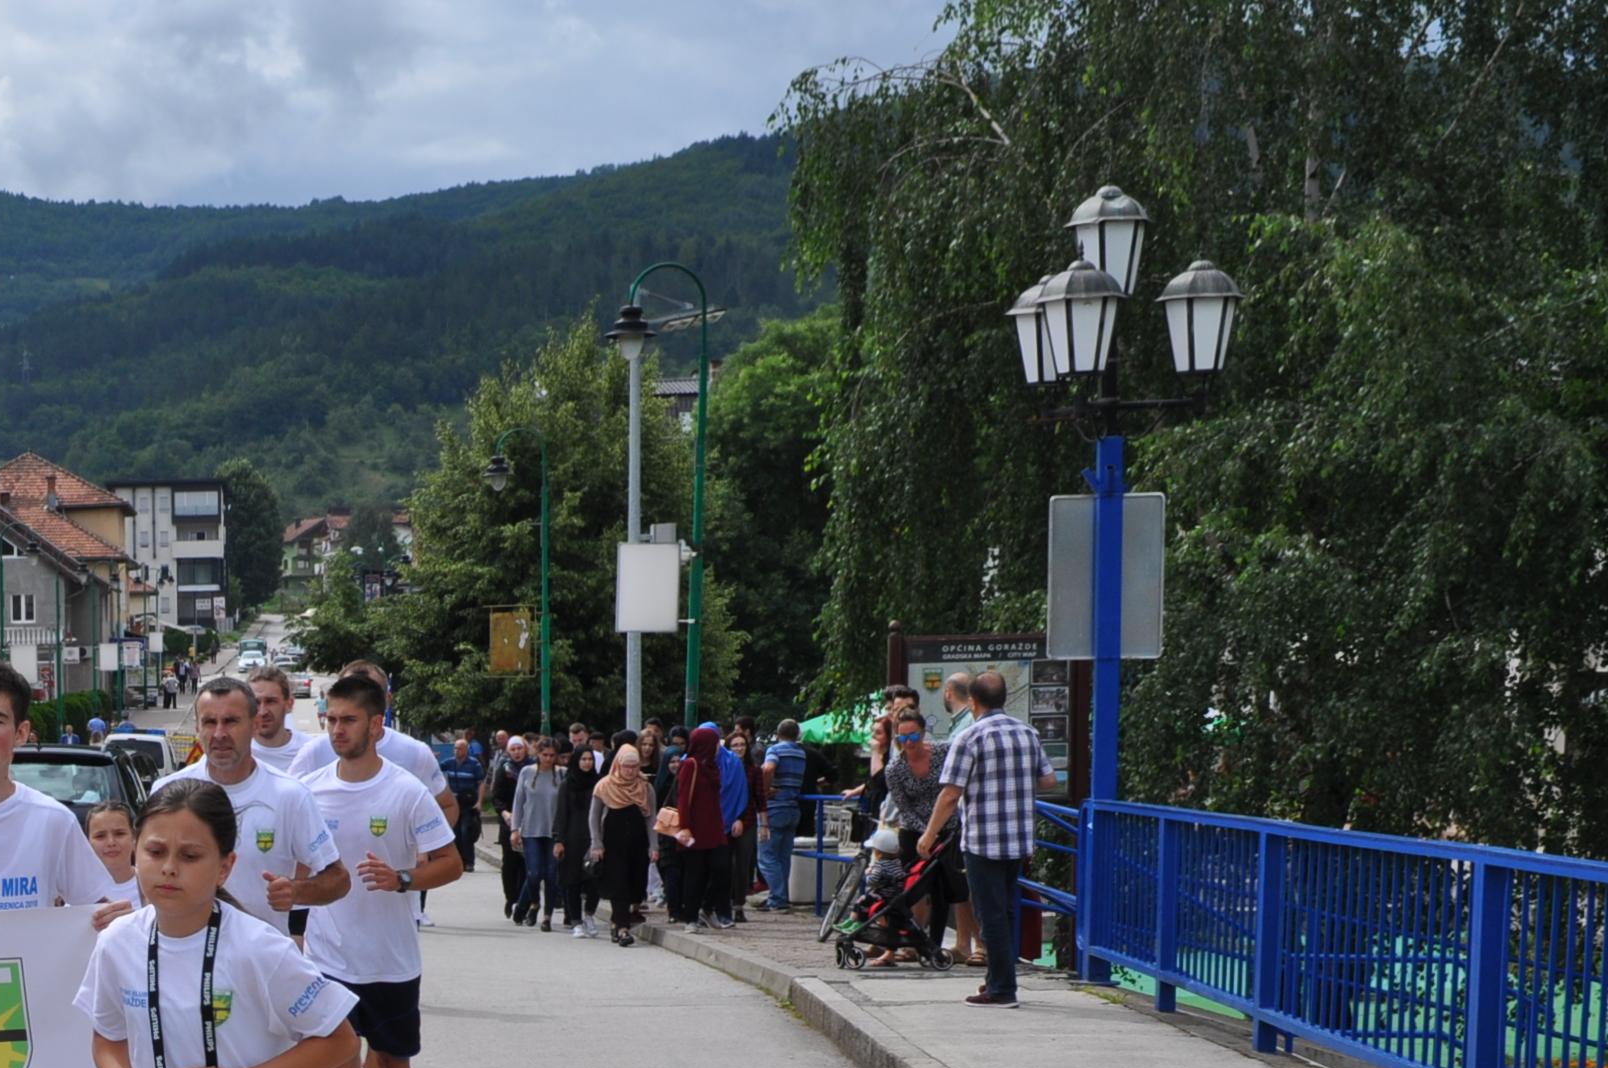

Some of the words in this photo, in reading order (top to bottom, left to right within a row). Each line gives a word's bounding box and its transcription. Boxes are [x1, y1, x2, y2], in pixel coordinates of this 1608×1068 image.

[2, 876, 38, 897] MIRA
[206, 926, 218, 958] PHILIPS
[203, 972, 212, 1006] PHILIPS
[288, 976, 325, 1017] prevent
[151, 1007, 160, 1040] PHILIPS
[205, 1020, 215, 1052] PHILIPS
